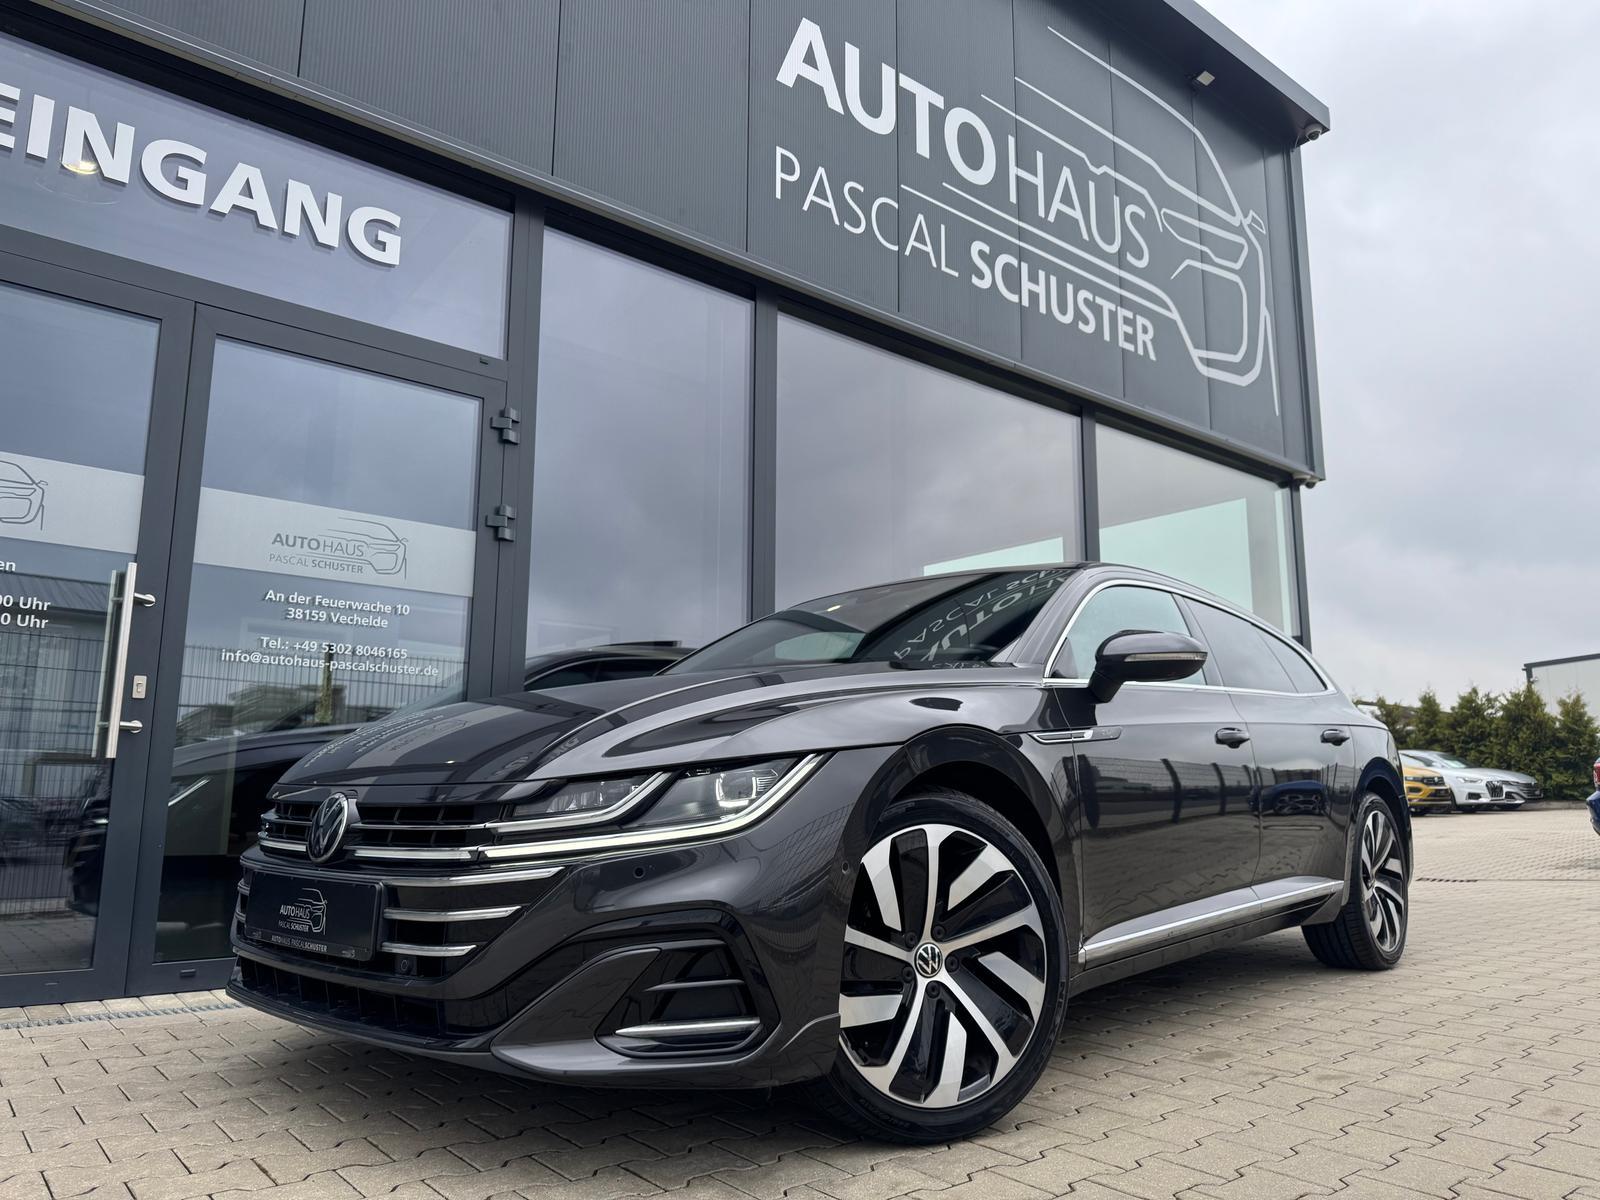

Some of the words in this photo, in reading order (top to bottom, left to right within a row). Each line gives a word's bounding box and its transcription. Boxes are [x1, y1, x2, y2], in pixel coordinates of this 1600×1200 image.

[776, 17, 1150, 268] AUTOHAUS
[775, 146, 958, 277] PASCAL
[970, 240, 1156, 361] SCHUSTER
[271, 532, 364, 557] AUTOHAUS
[269, 553, 308, 568] PASCAL
[311, 559, 364, 574] SCHUSTER
[19, 595, 52, 611] Uhr
[265, 589, 285, 602] An
[288, 592, 311, 605] der
[315, 595, 392, 614] Feuerwache
[396, 603, 410, 615] 10
[16, 613, 49, 629] Uhr
[286, 607, 327, 622] 38159
[331, 612, 389, 628] Vechelde
[260, 636, 289, 650] Tel.:
[293, 640, 318, 652] +49
[321, 642, 352, 655] 5302
[355, 645, 408, 659] 8046165
[221, 649, 439, 677] info@autohaus-pascalschuster.de
[279, 904, 310, 919] AUTOHAUS
[291, 922, 310, 933] SCHUSTER
